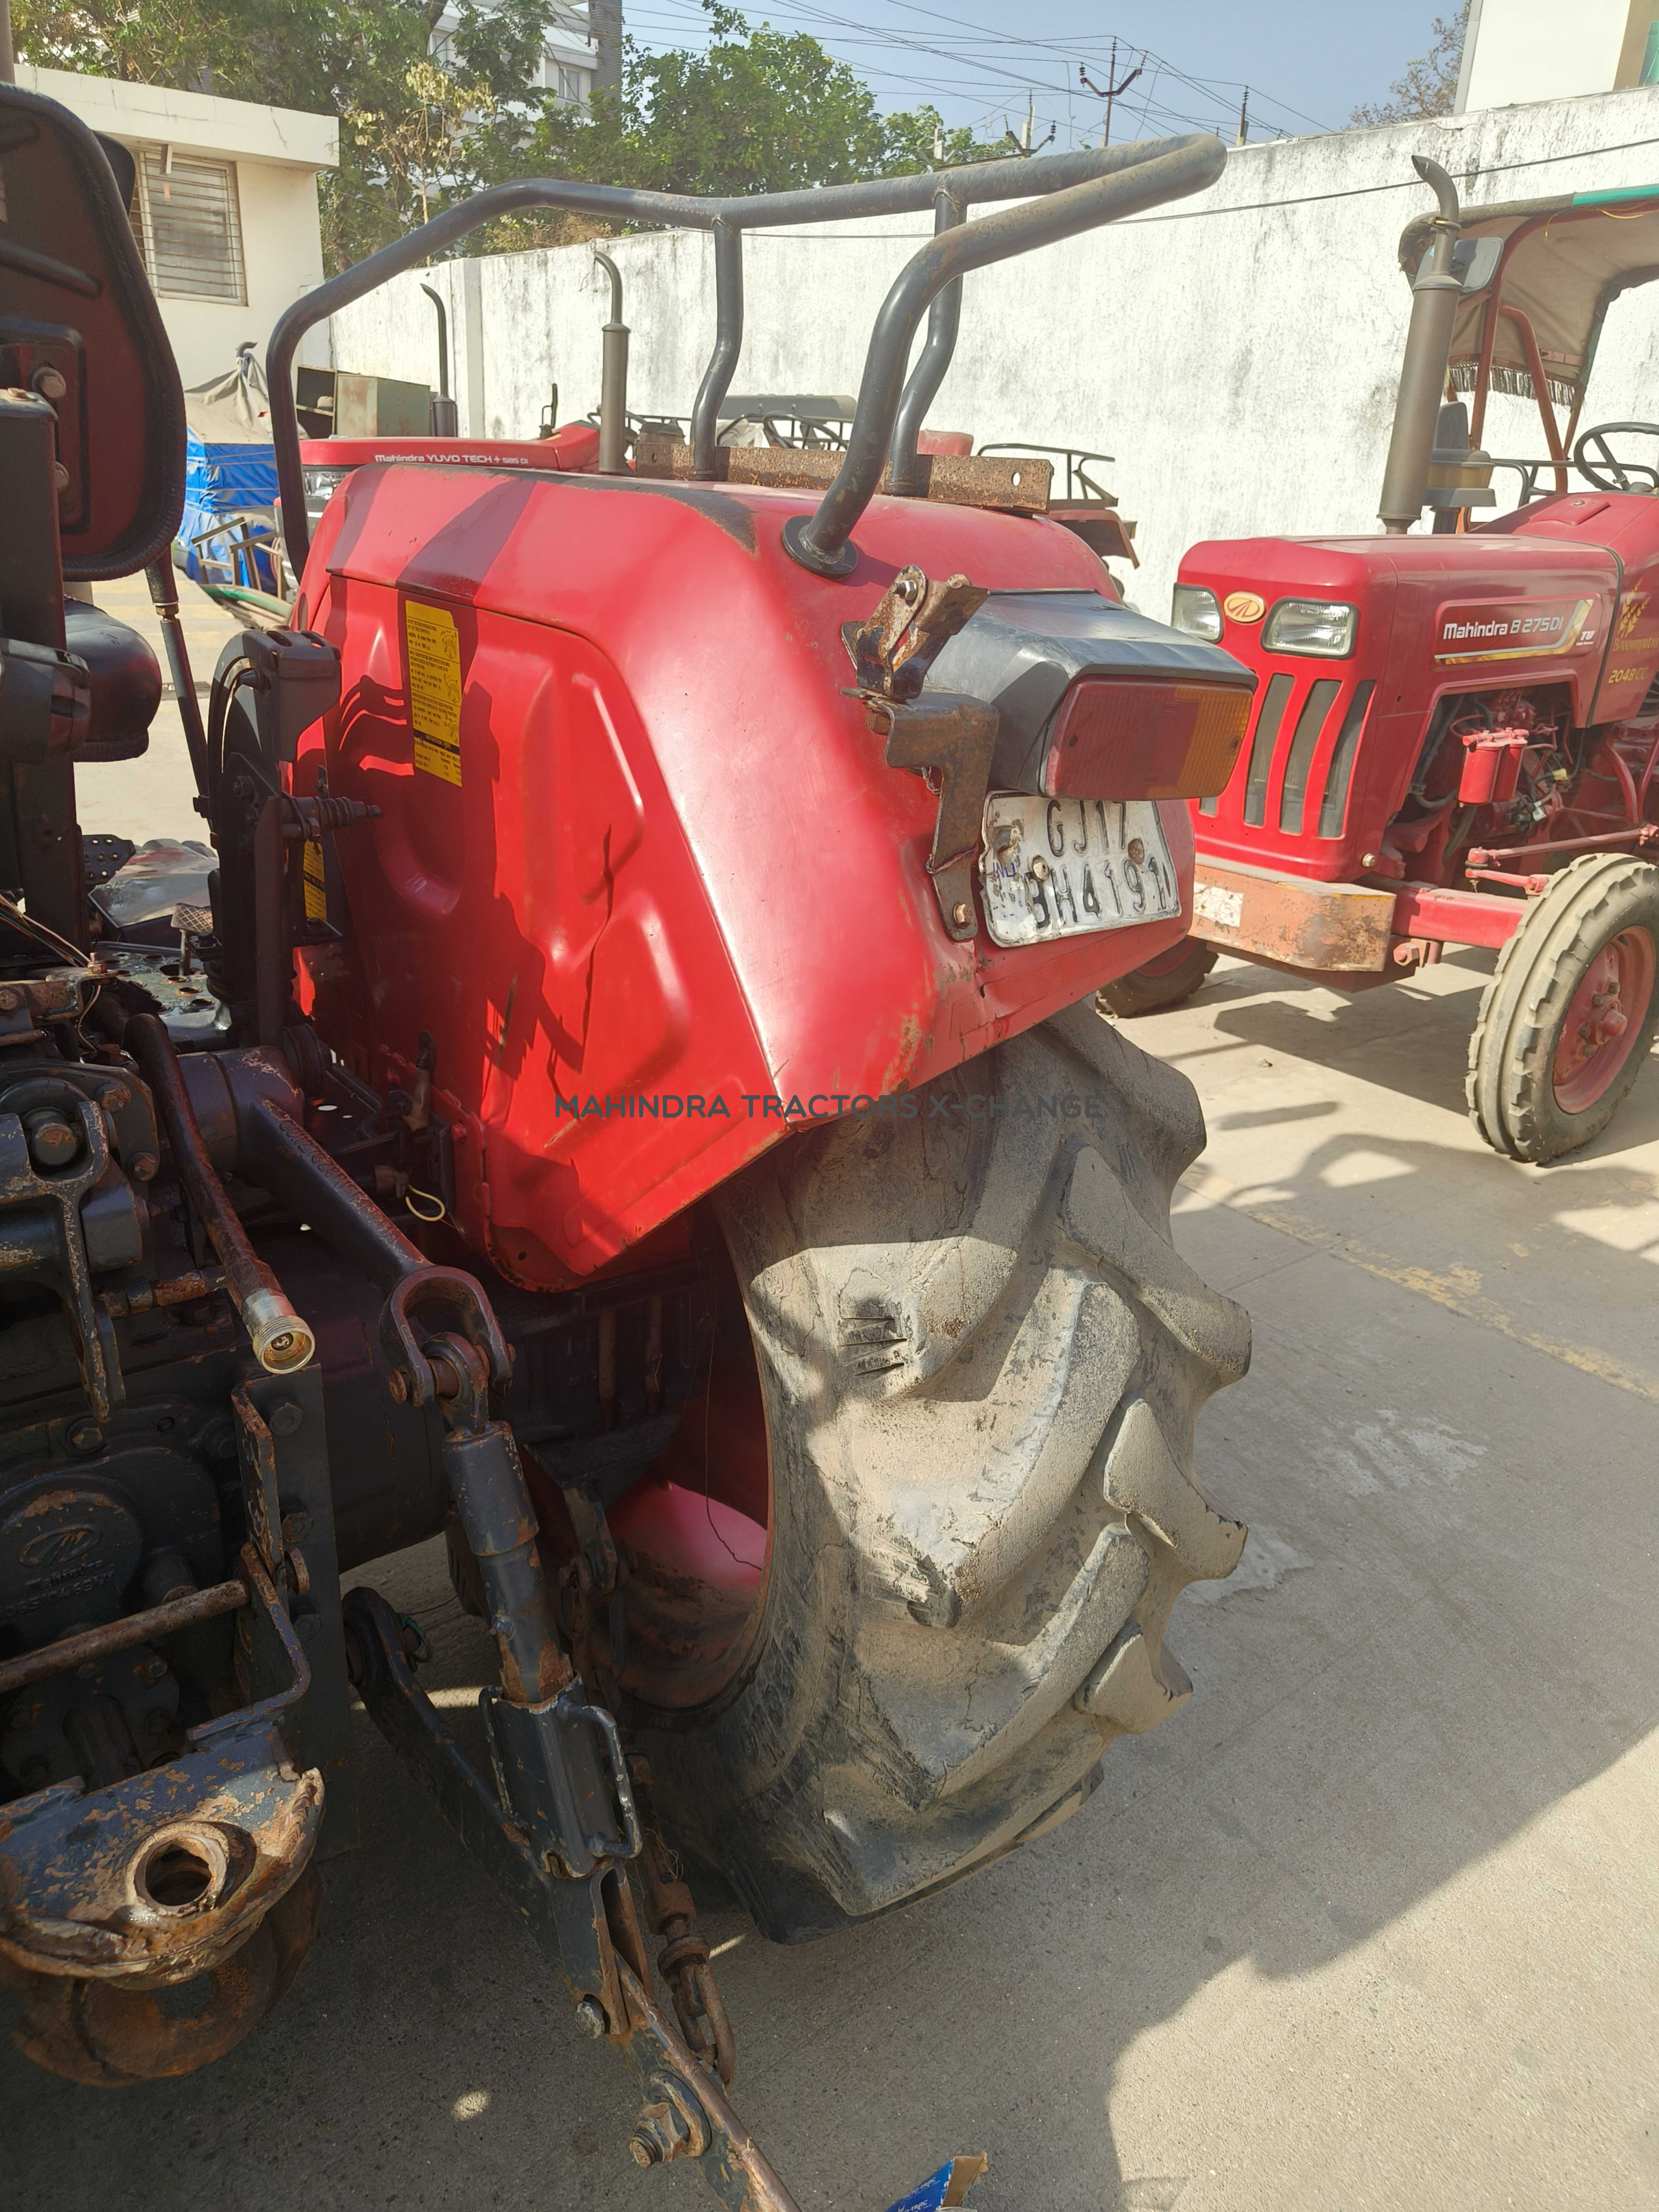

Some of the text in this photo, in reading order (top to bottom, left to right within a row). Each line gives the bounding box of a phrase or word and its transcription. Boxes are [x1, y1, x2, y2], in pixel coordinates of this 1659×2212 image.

[426, 455, 460, 463] YUVO
[1443, 621, 1508, 639] Mahindra
[1509, 619, 1521, 634] B
